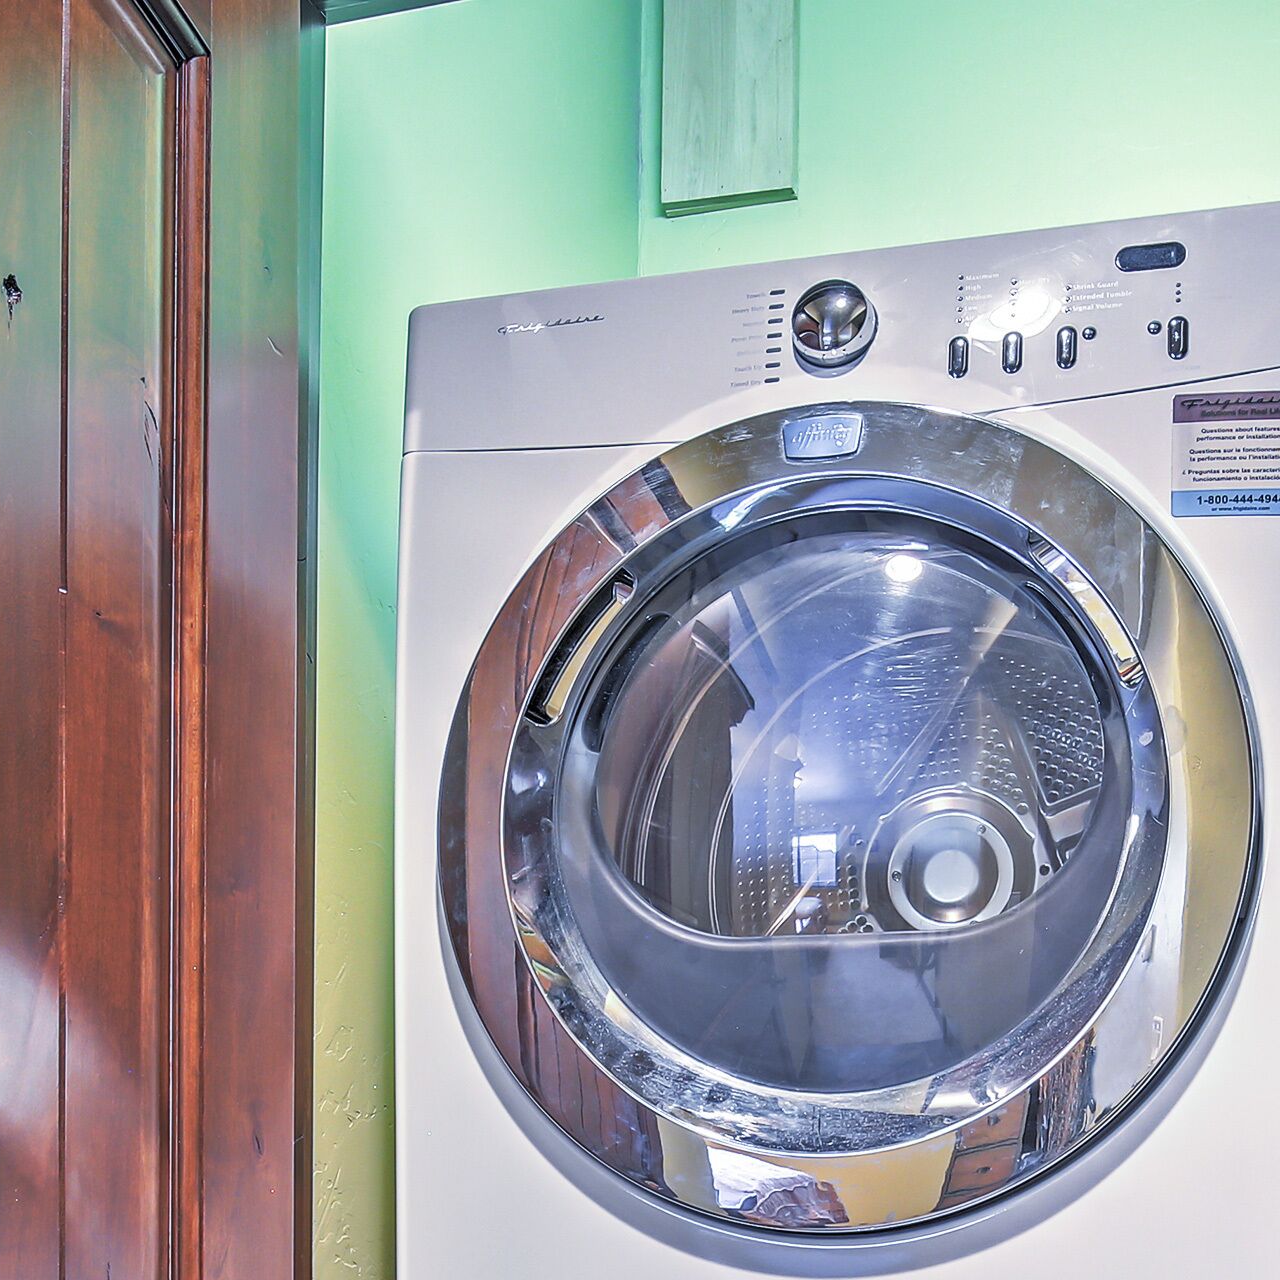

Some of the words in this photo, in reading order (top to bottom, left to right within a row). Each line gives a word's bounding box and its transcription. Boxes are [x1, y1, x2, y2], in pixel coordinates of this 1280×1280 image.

[1072, 282, 1096, 291] Shrink
[1097, 280, 1119, 289] Guard
[1072, 291, 1105, 301] Extended
[1106, 289, 1133, 299] Tumble
[1095, 301, 1123, 311] Volume
[498, 315, 604, 335] Frigidaire
[1200, 409, 1236, 418] Solutions
[1250, 408, 1268, 416] Real
[1197, 455, 1237, 463] performance
[1187, 468, 1220, 476] Preguntas
